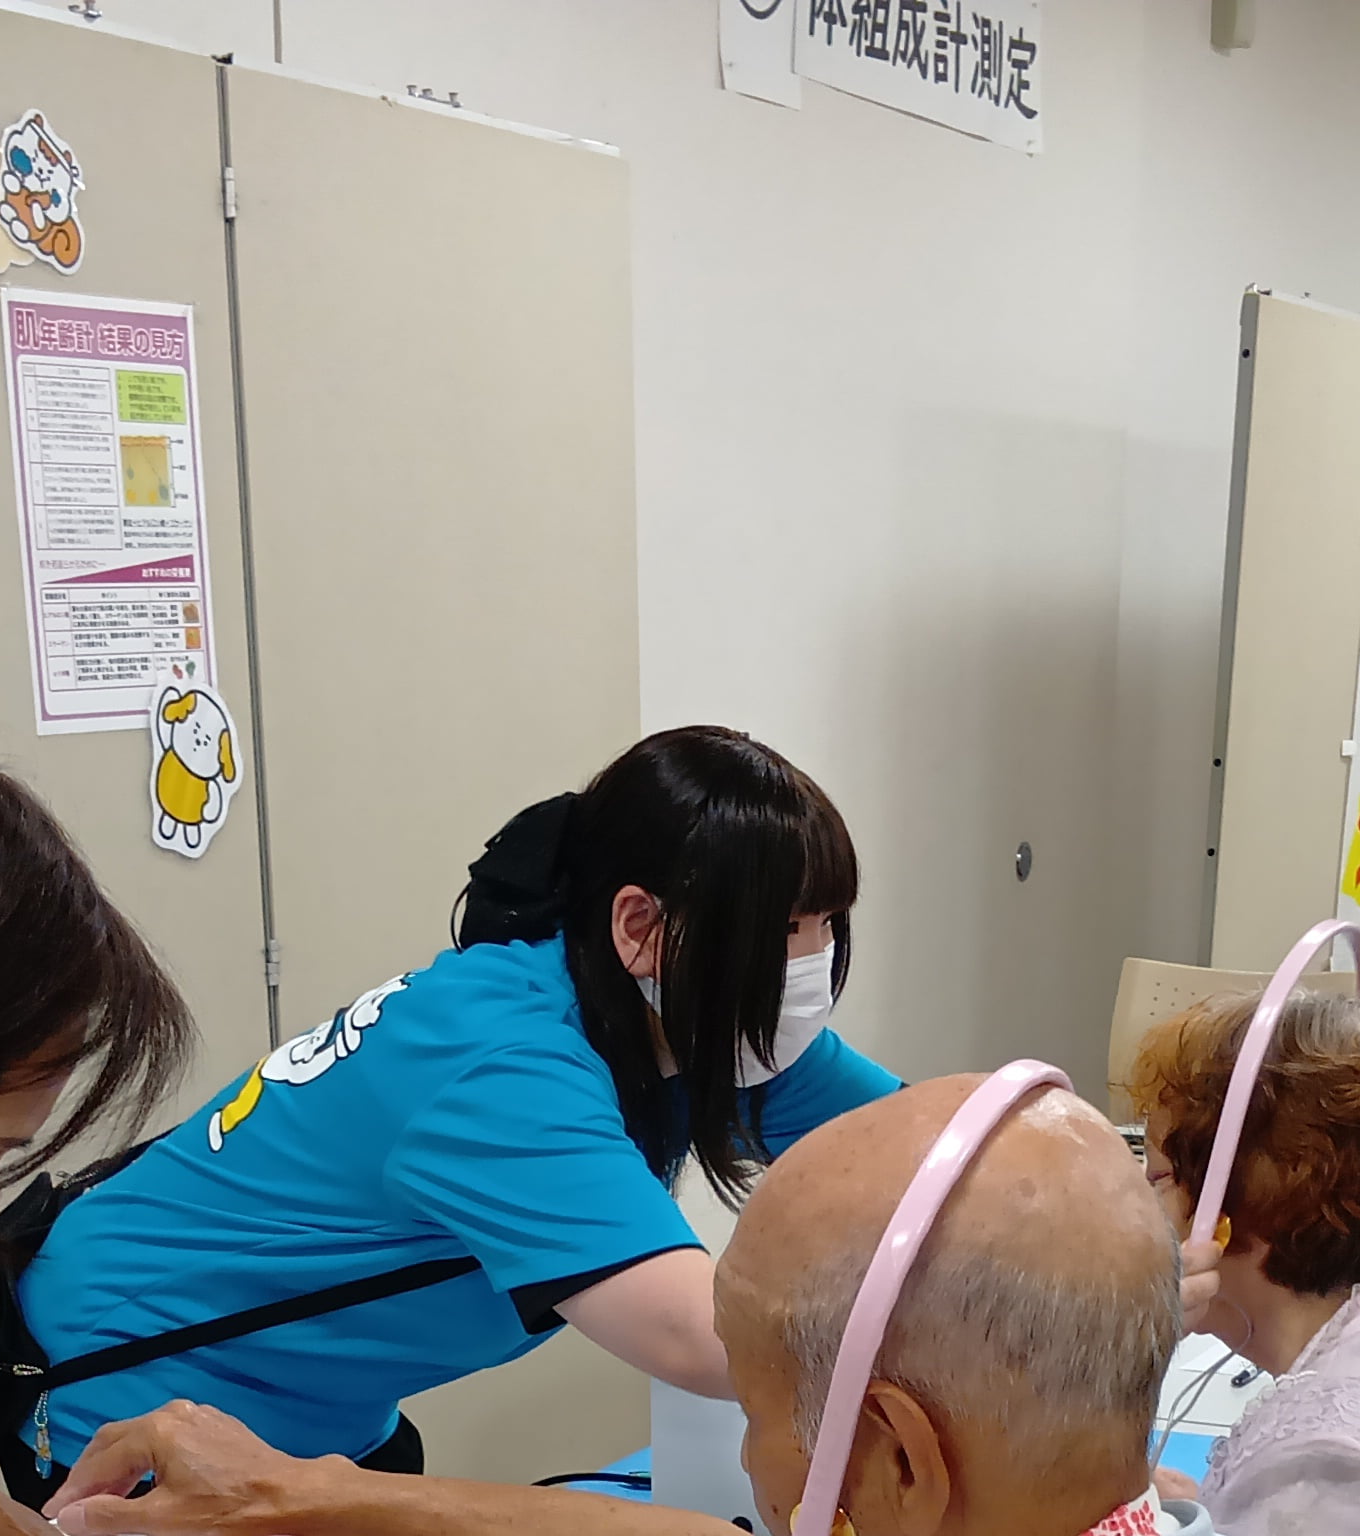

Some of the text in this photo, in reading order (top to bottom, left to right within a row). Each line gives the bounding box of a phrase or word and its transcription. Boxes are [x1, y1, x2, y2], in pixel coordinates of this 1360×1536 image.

[808, 0, 1039, 119] 体組成計測定
[14, 308, 185, 360] 肌年齢計 結果の見方
